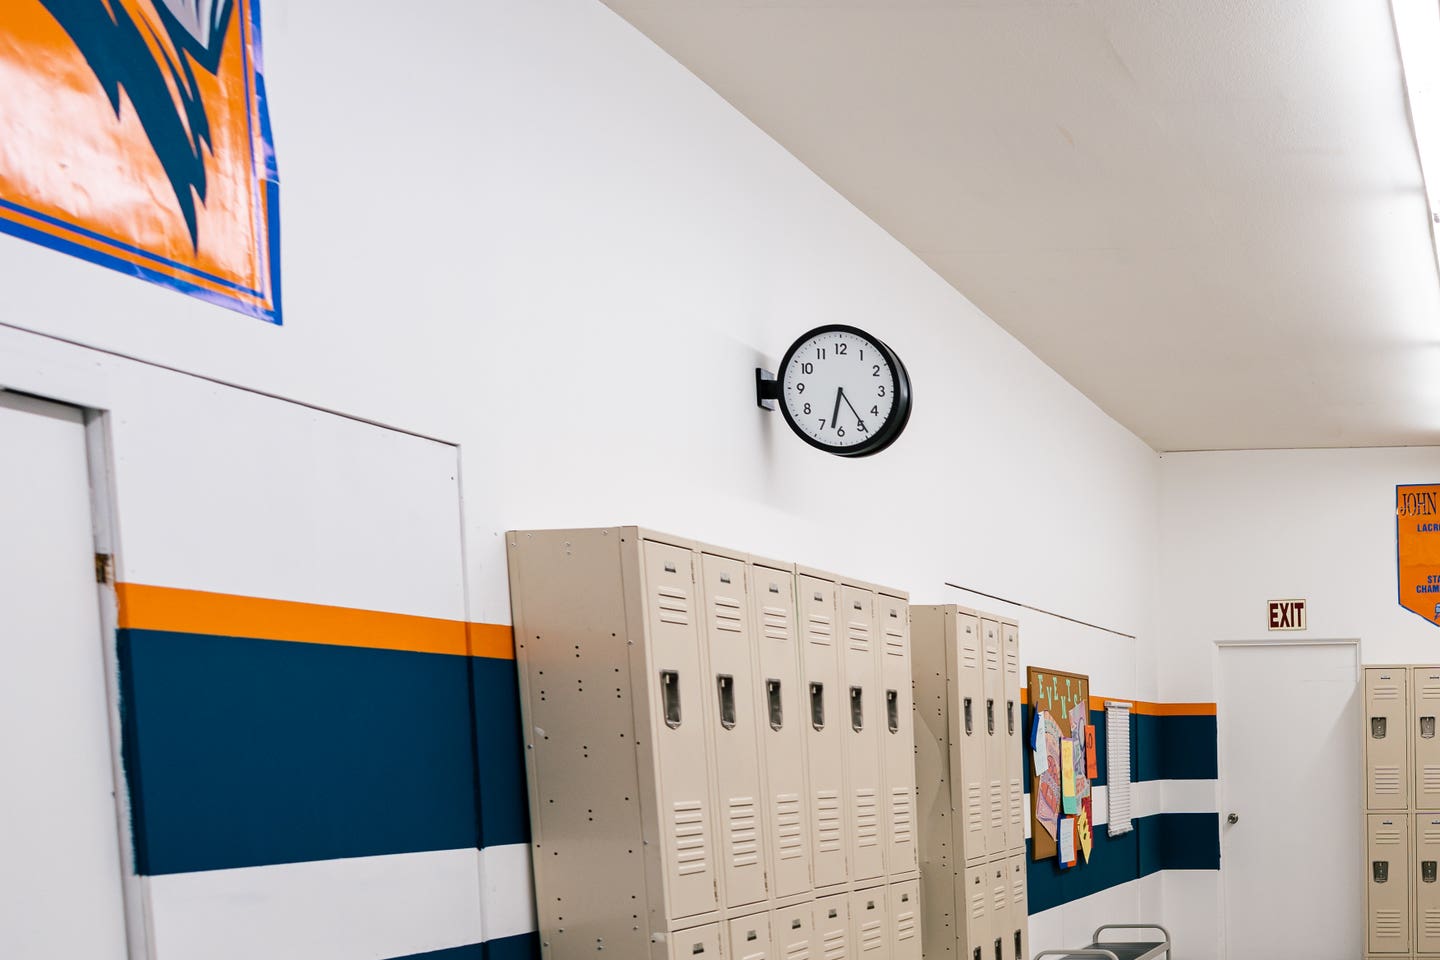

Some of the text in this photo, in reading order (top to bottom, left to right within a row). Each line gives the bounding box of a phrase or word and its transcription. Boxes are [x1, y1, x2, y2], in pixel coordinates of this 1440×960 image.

[817, 349, 826, 360] 11
[835, 343, 847, 355] 12
[859, 349, 864, 361] 1
[801, 362, 814, 375] 10
[872, 365, 880, 377] 2
[796, 382, 805, 394] 9
[877, 385, 886, 397] 3
[803, 402, 811, 415] 8
[870, 405, 879, 416] 4
[818, 418, 826, 430] 7
[856, 420, 865, 432] 5
[837, 426, 845, 437] 6
[1400, 491, 1437, 517] JOHN
[1269, 602, 1304, 628] EXIT
